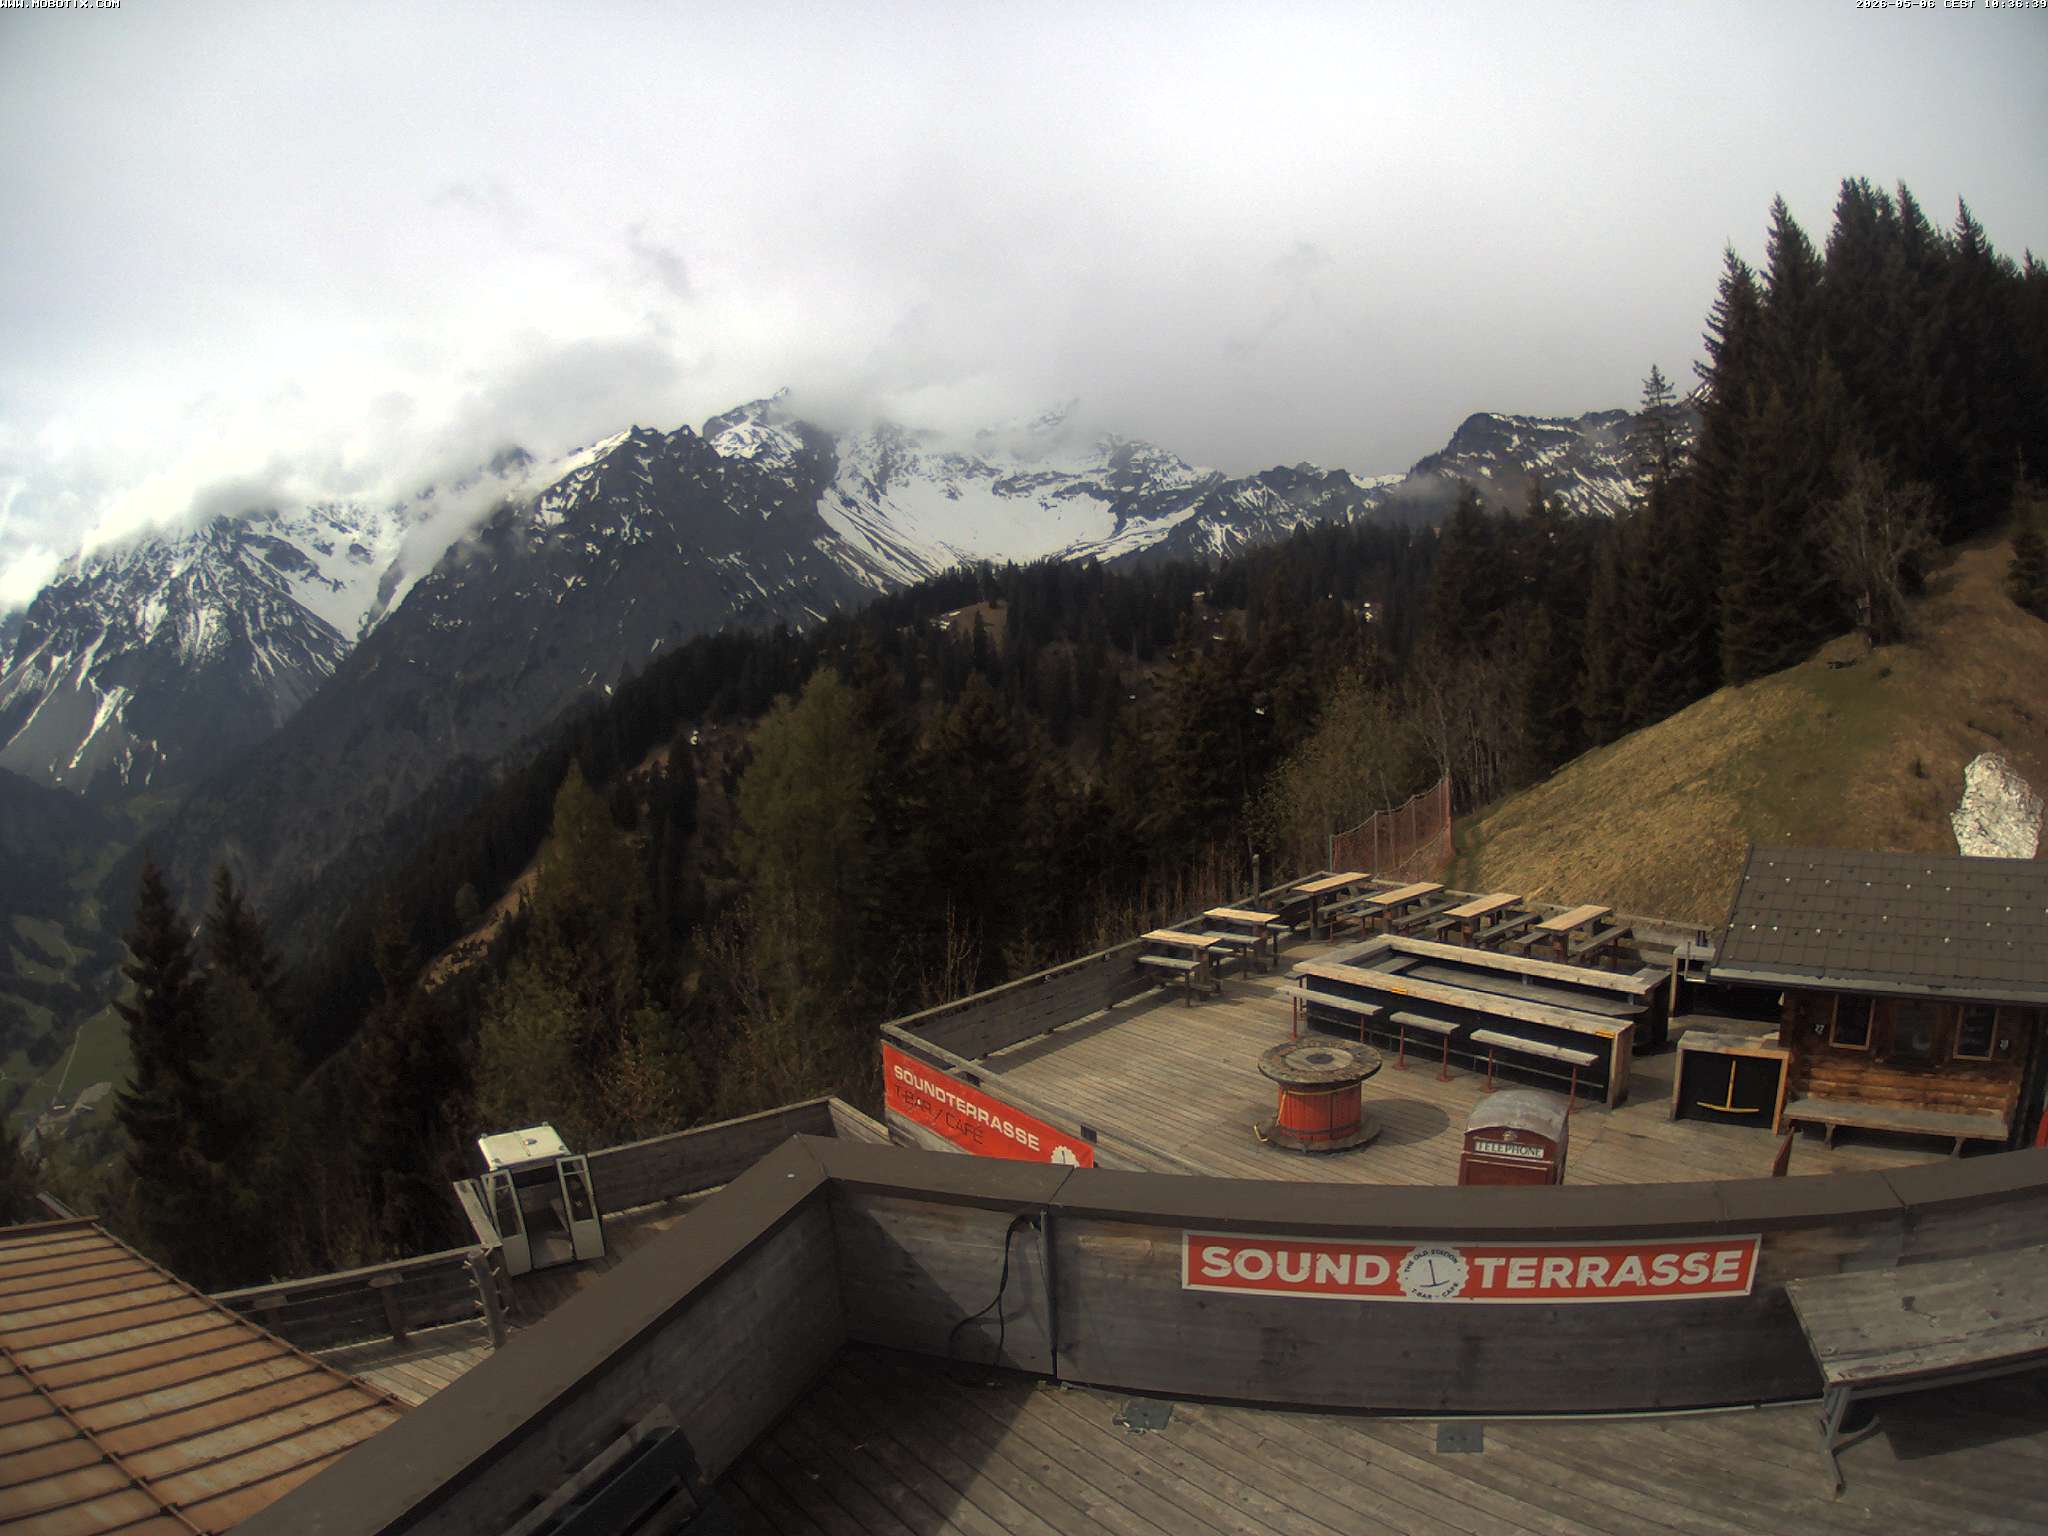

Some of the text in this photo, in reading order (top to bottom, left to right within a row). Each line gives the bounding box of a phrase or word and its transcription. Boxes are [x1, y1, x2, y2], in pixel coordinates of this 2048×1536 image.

[893, 1065, 1041, 1152] SOUNDTERRASSE
[1477, 1141, 1542, 1157] TELEPHONE
[1200, 1246, 1744, 1289] SOUND TERRASSE
